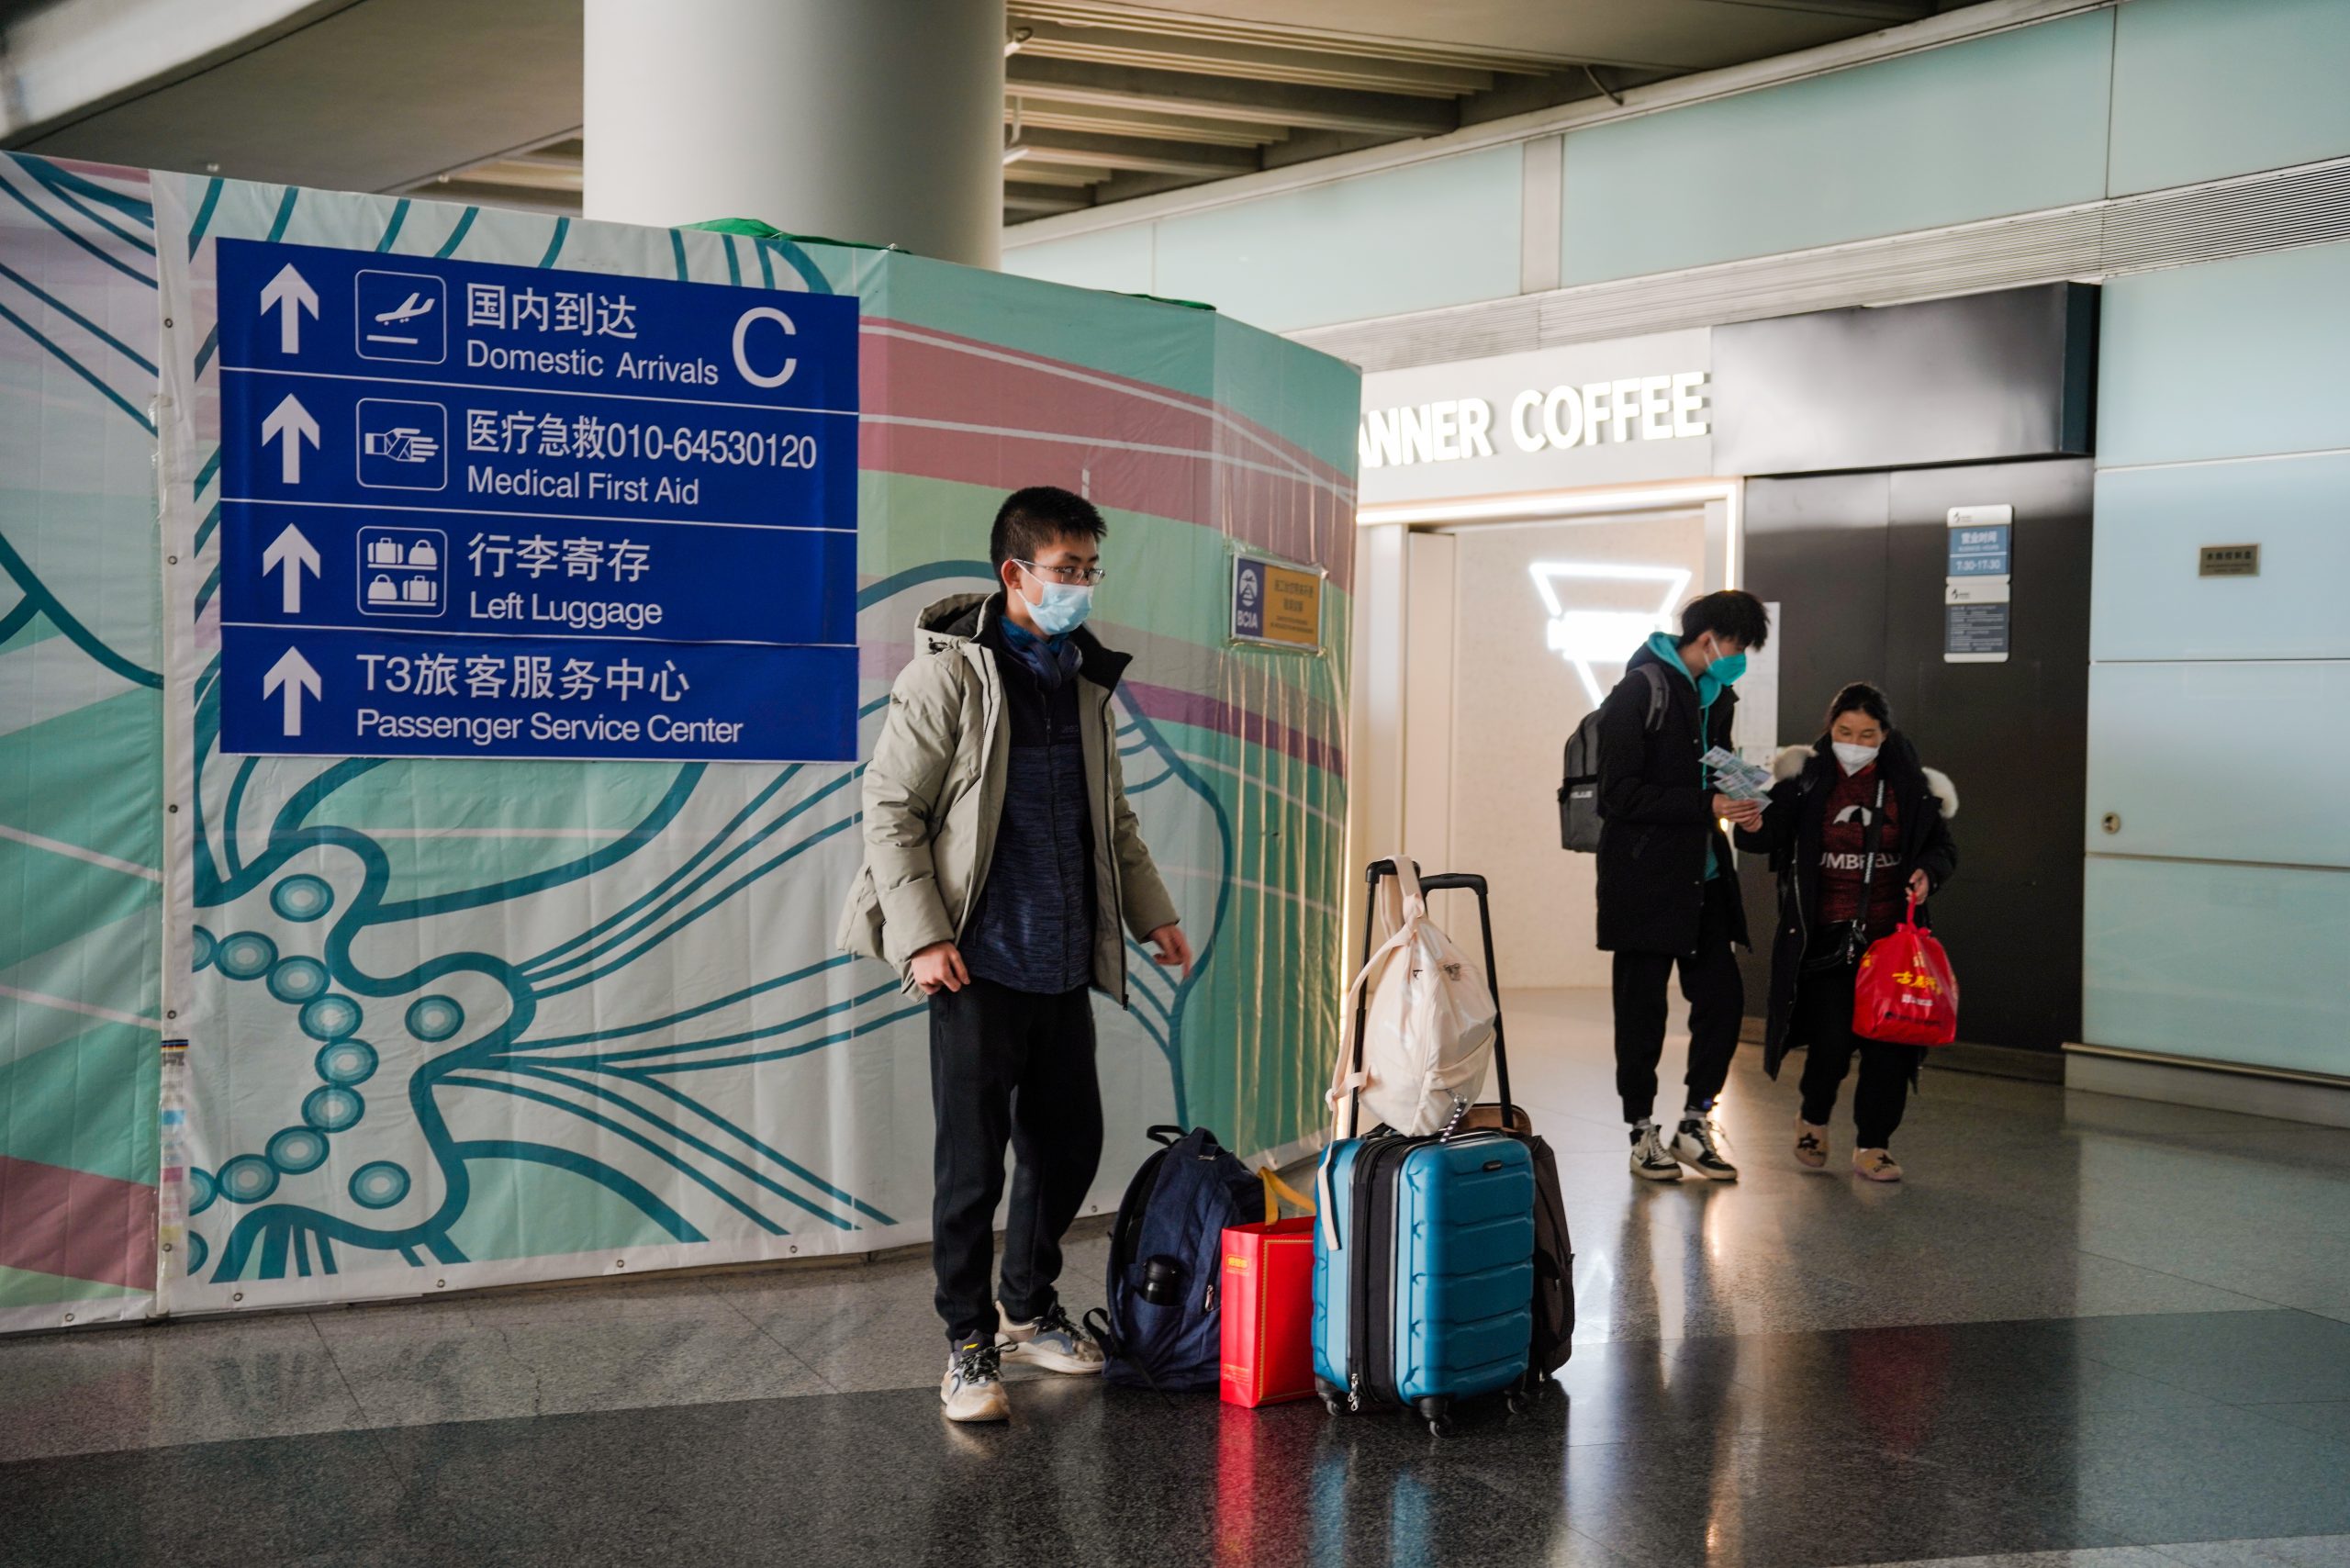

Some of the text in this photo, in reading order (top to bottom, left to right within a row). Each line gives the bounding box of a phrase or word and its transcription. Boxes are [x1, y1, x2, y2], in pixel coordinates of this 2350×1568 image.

[466, 282, 638, 340] 国内到达
[466, 339, 719, 386] Domestic Arrivals
[732, 306, 798, 388] C
[1510, 371, 1707, 453] COFFEE
[466, 409, 817, 469] 医疗急救010-64530120
[467, 465, 700, 505] Medical First Aid
[467, 532, 651, 582] 行李寄存
[470, 591, 663, 631] Left Luggage
[1237, 610, 1259, 629] BCIA
[356, 653, 690, 702] T3旅客服务中心
[356, 709, 744, 746] Passenger Service Center
